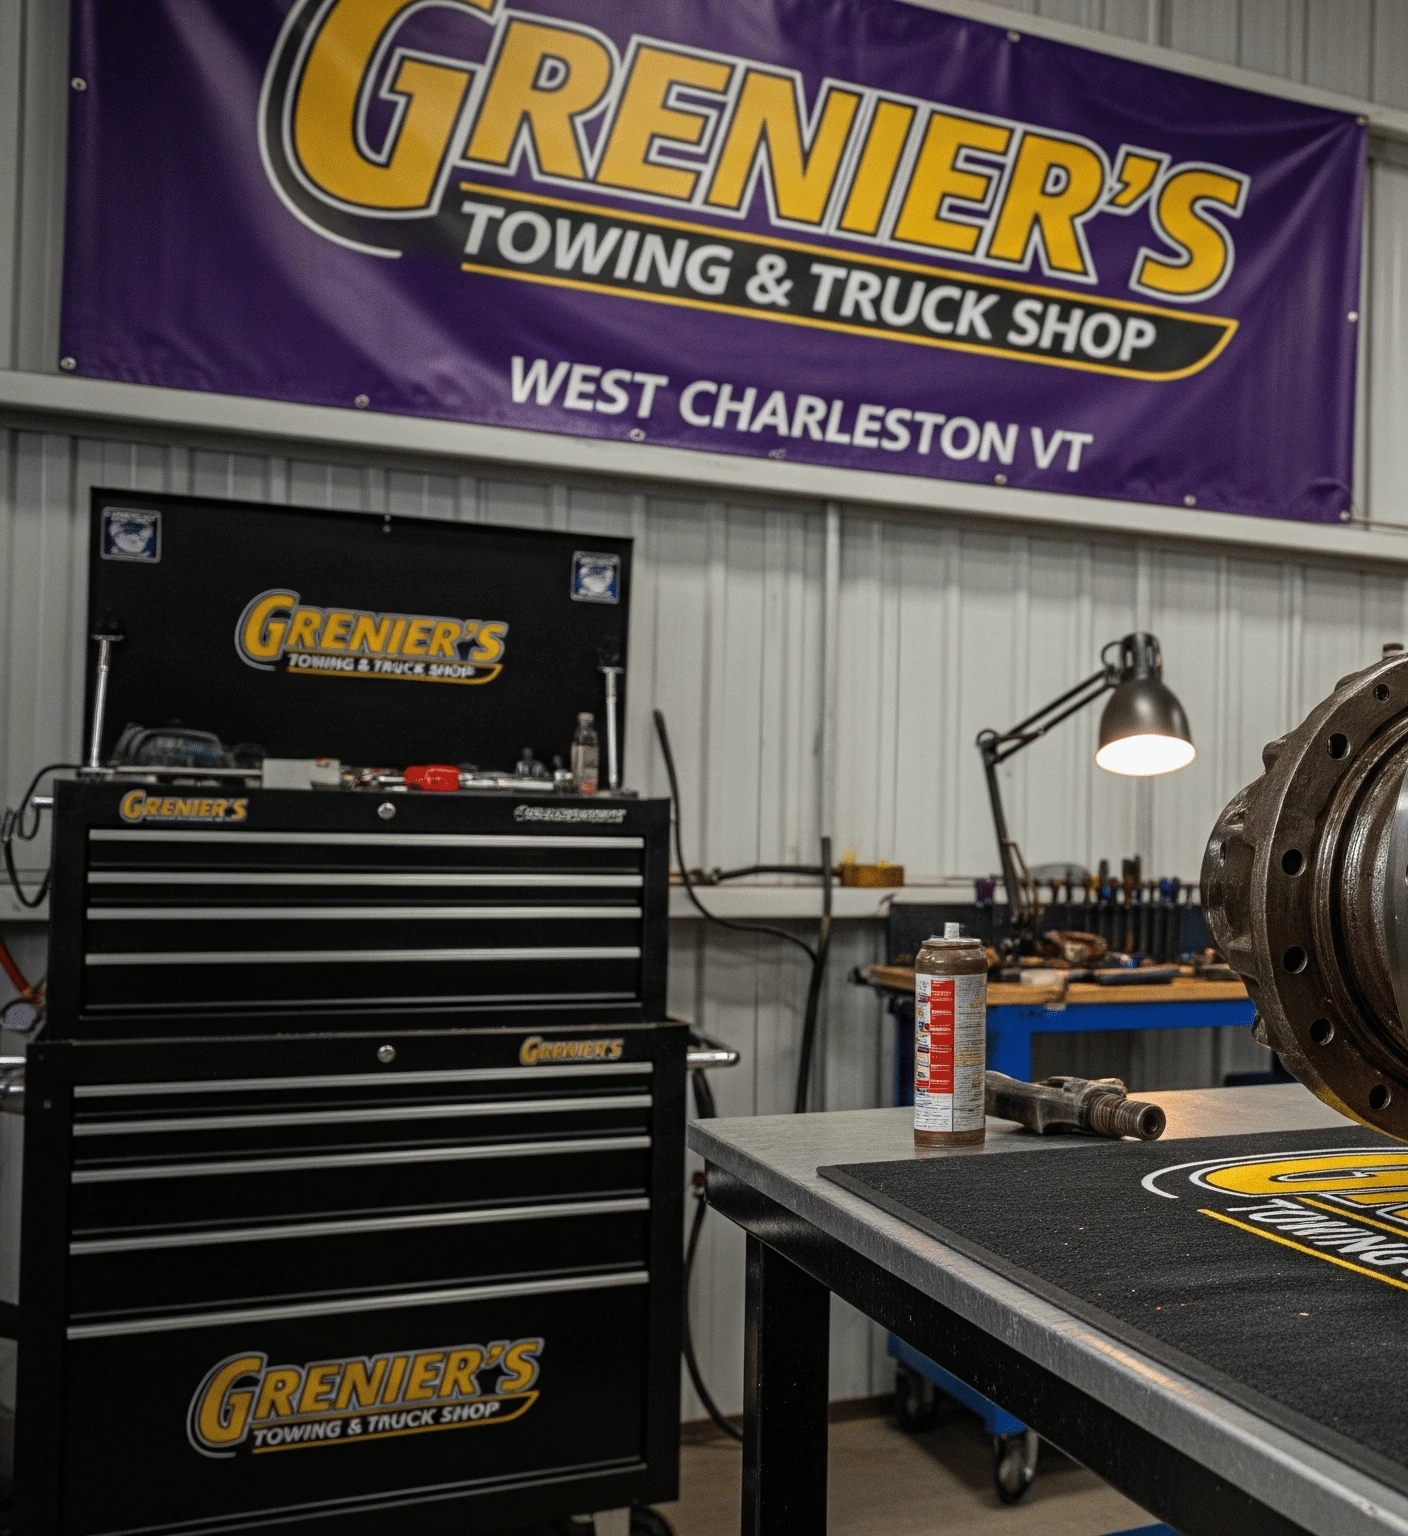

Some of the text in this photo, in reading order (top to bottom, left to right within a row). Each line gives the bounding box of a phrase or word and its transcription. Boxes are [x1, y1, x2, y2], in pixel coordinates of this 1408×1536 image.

[281, 0, 1248, 303] GRENIER'S
[461, 201, 1157, 361] TOWING & TRUCK SHOP
[511, 355, 1094, 472] WEST CHARLESTON VT
[241, 588, 509, 663] GRENIER'S
[288, 653, 476, 678] TOWING & TRUCK SHOP
[196, 1337, 545, 1448] GRENIER'S
[253, 1401, 500, 1446] TOWING & TRUCK SHOP
